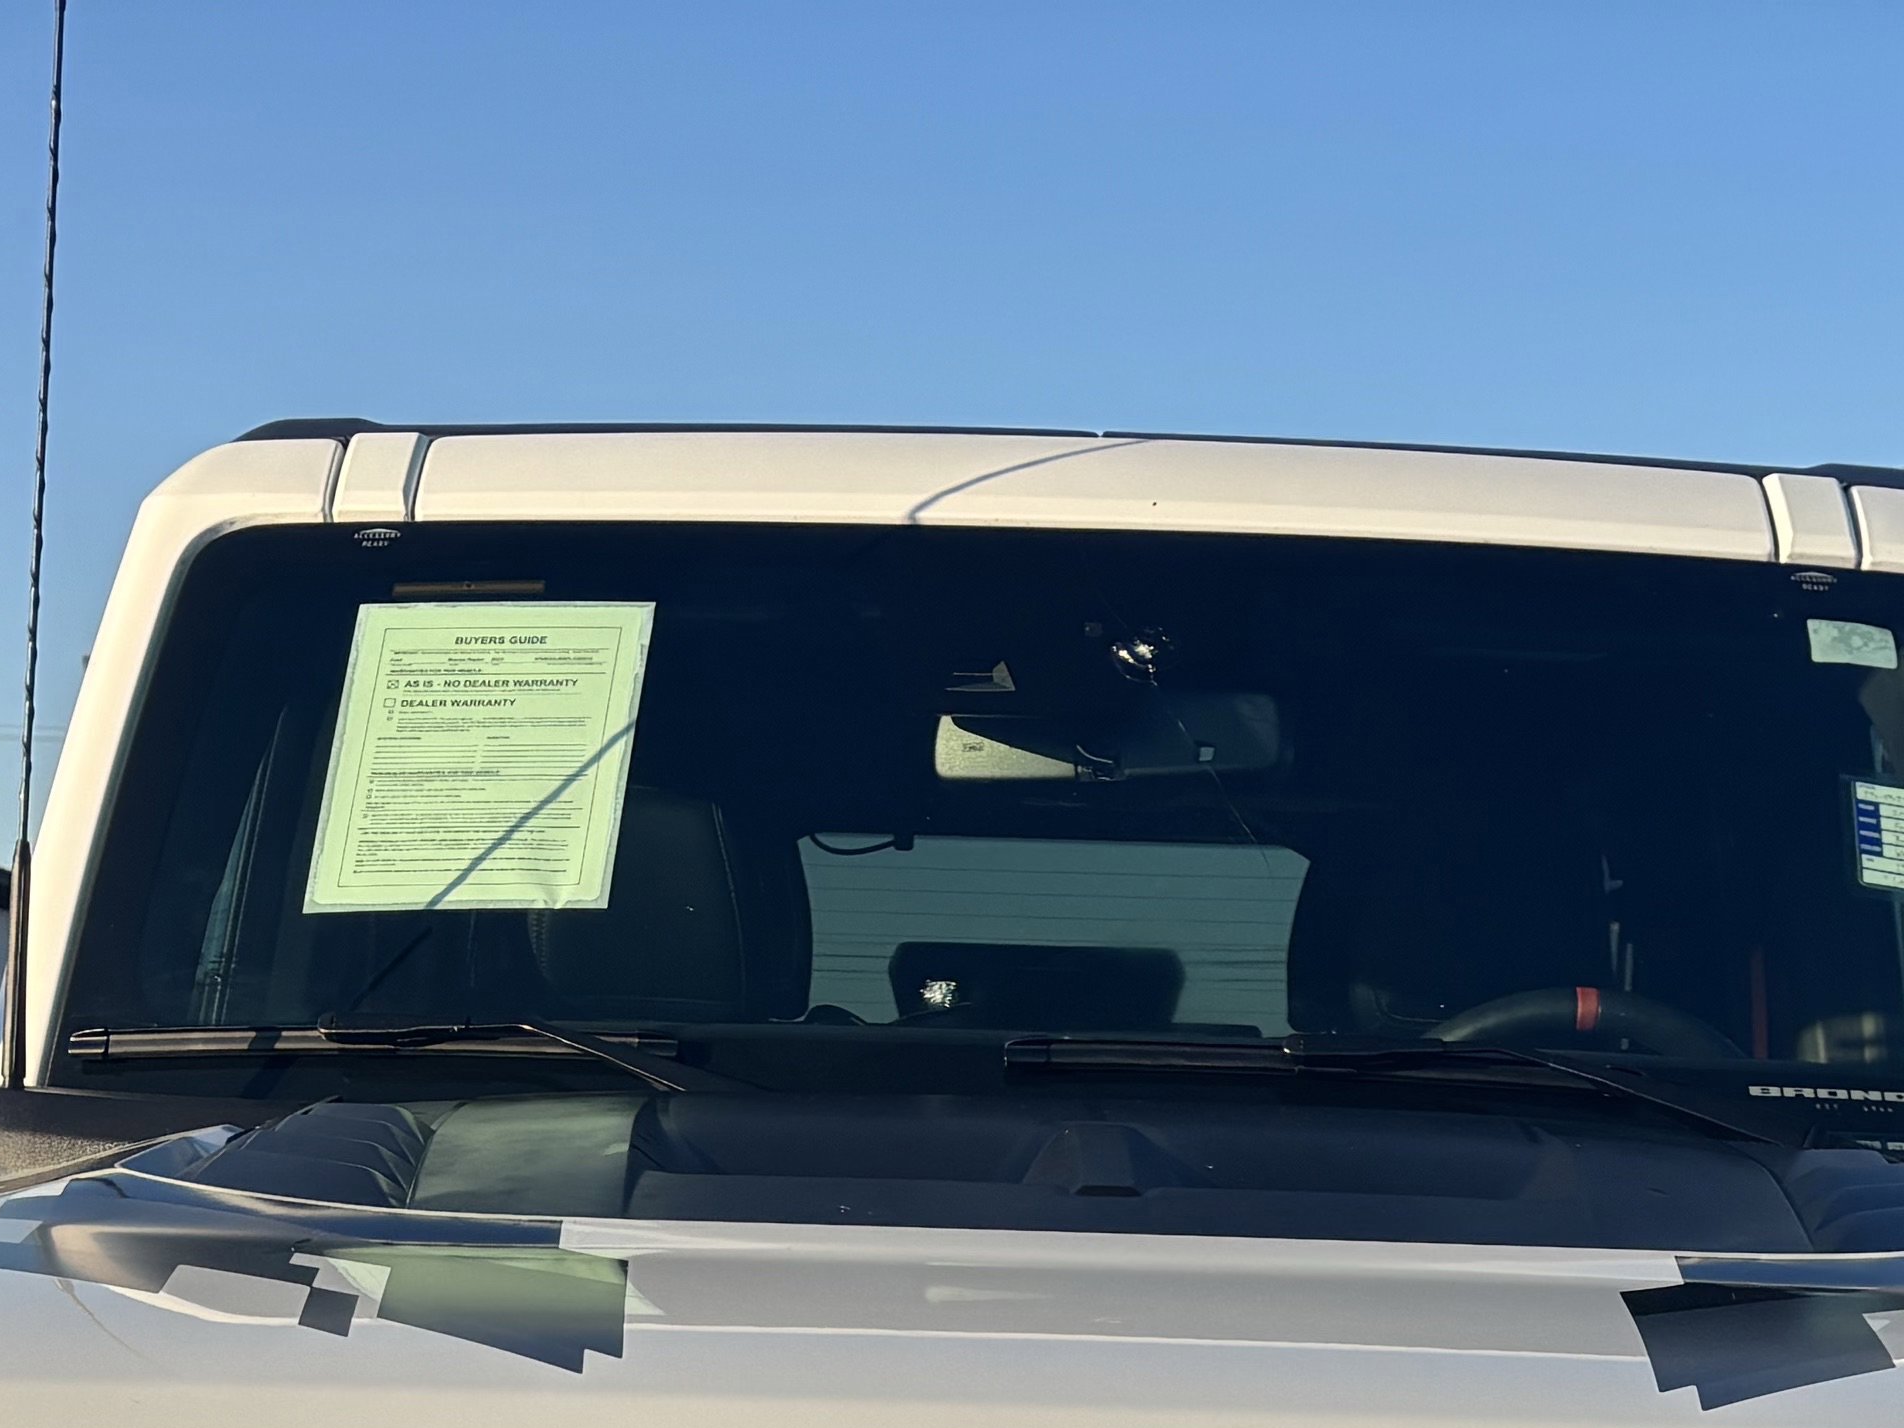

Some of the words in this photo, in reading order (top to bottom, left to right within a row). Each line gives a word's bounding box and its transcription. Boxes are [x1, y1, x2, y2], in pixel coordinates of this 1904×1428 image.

[454, 636, 506, 645] BUYERS
[508, 635, 548, 645] GUIDE
[404, 679, 421, 688] AS
[422, 679, 434, 688] IS
[443, 679, 461, 688] NO
[463, 679, 510, 688] DEALER
[513, 678, 579, 688] WARRANTY
[400, 698, 448, 708] DEALER
[450, 698, 517, 707] WARRANTY
